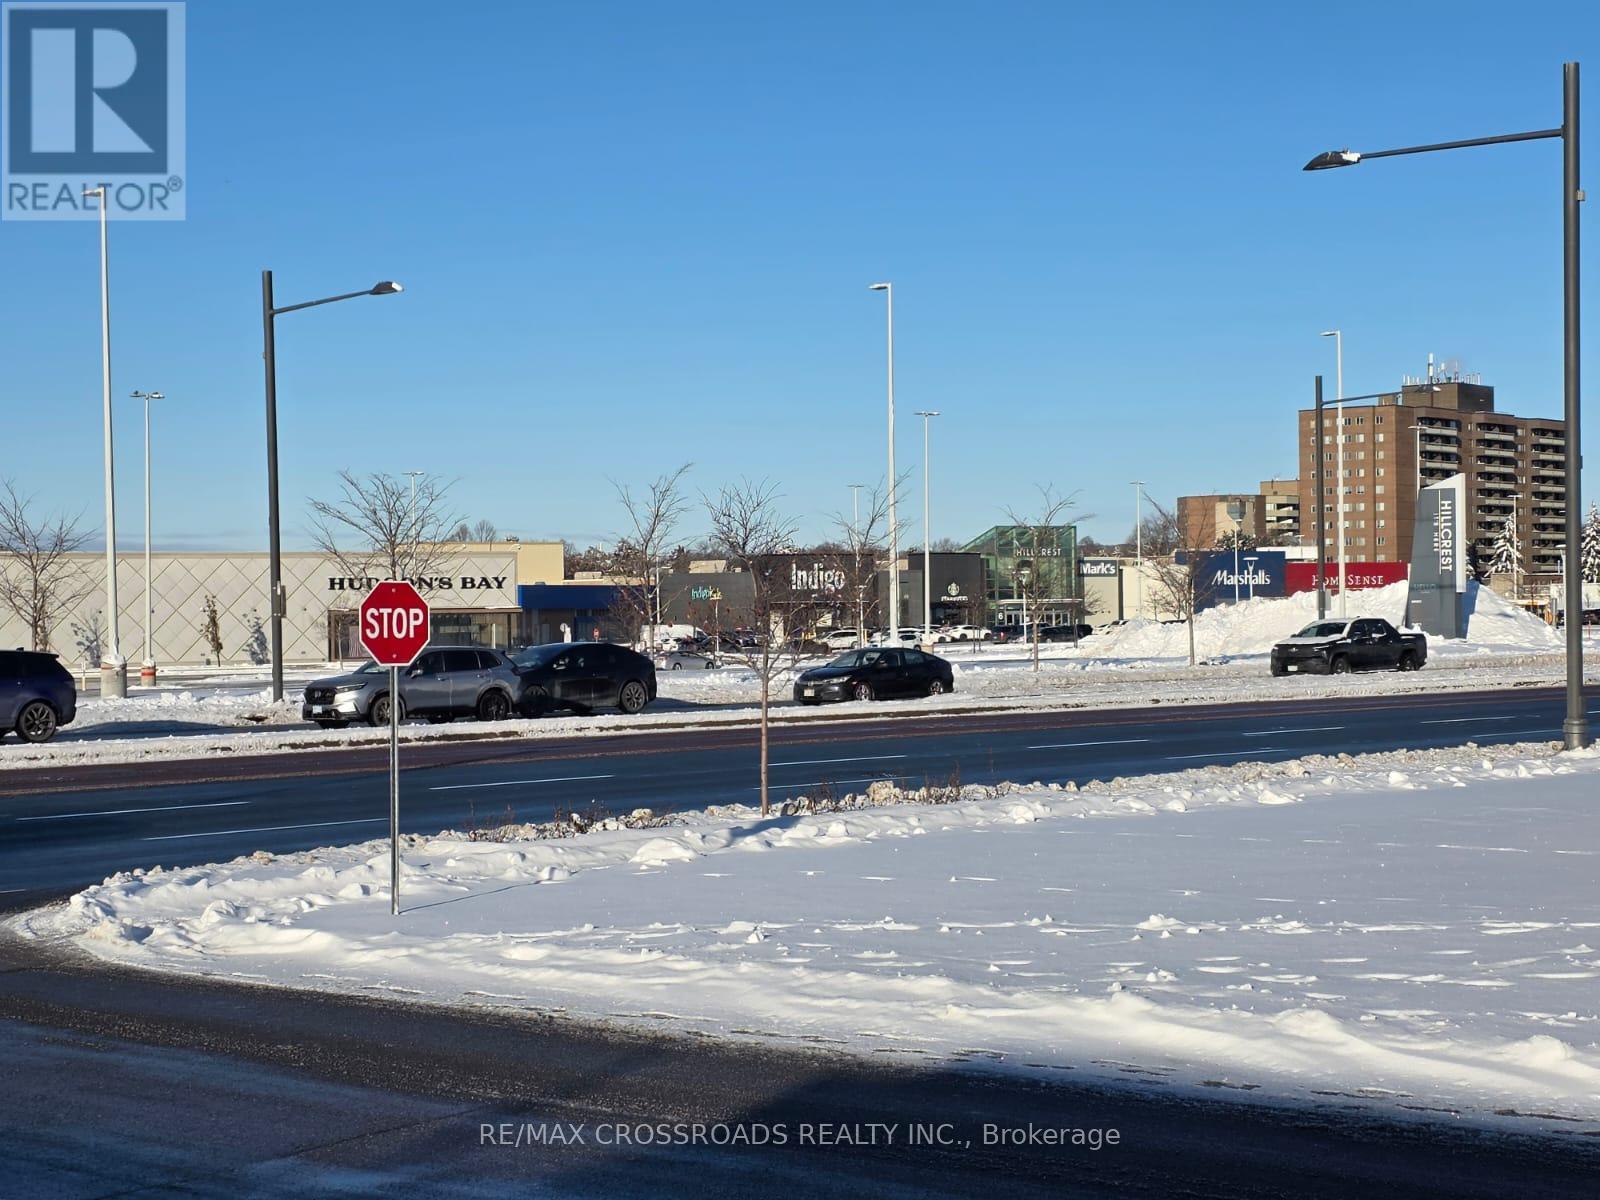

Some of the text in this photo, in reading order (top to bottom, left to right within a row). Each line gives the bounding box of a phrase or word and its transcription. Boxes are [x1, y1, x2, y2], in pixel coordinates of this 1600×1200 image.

[1440, 500, 1452, 572] HILLCREST
[1016, 547, 1062, 557] HILLREST
[1080, 562, 1116, 575] Mark's
[461, 577, 507, 590] BAY
[791, 562, 845, 594] Indigo
[1211, 569, 1271, 586] Marshalls
[365, 608, 424, 639] STOP
